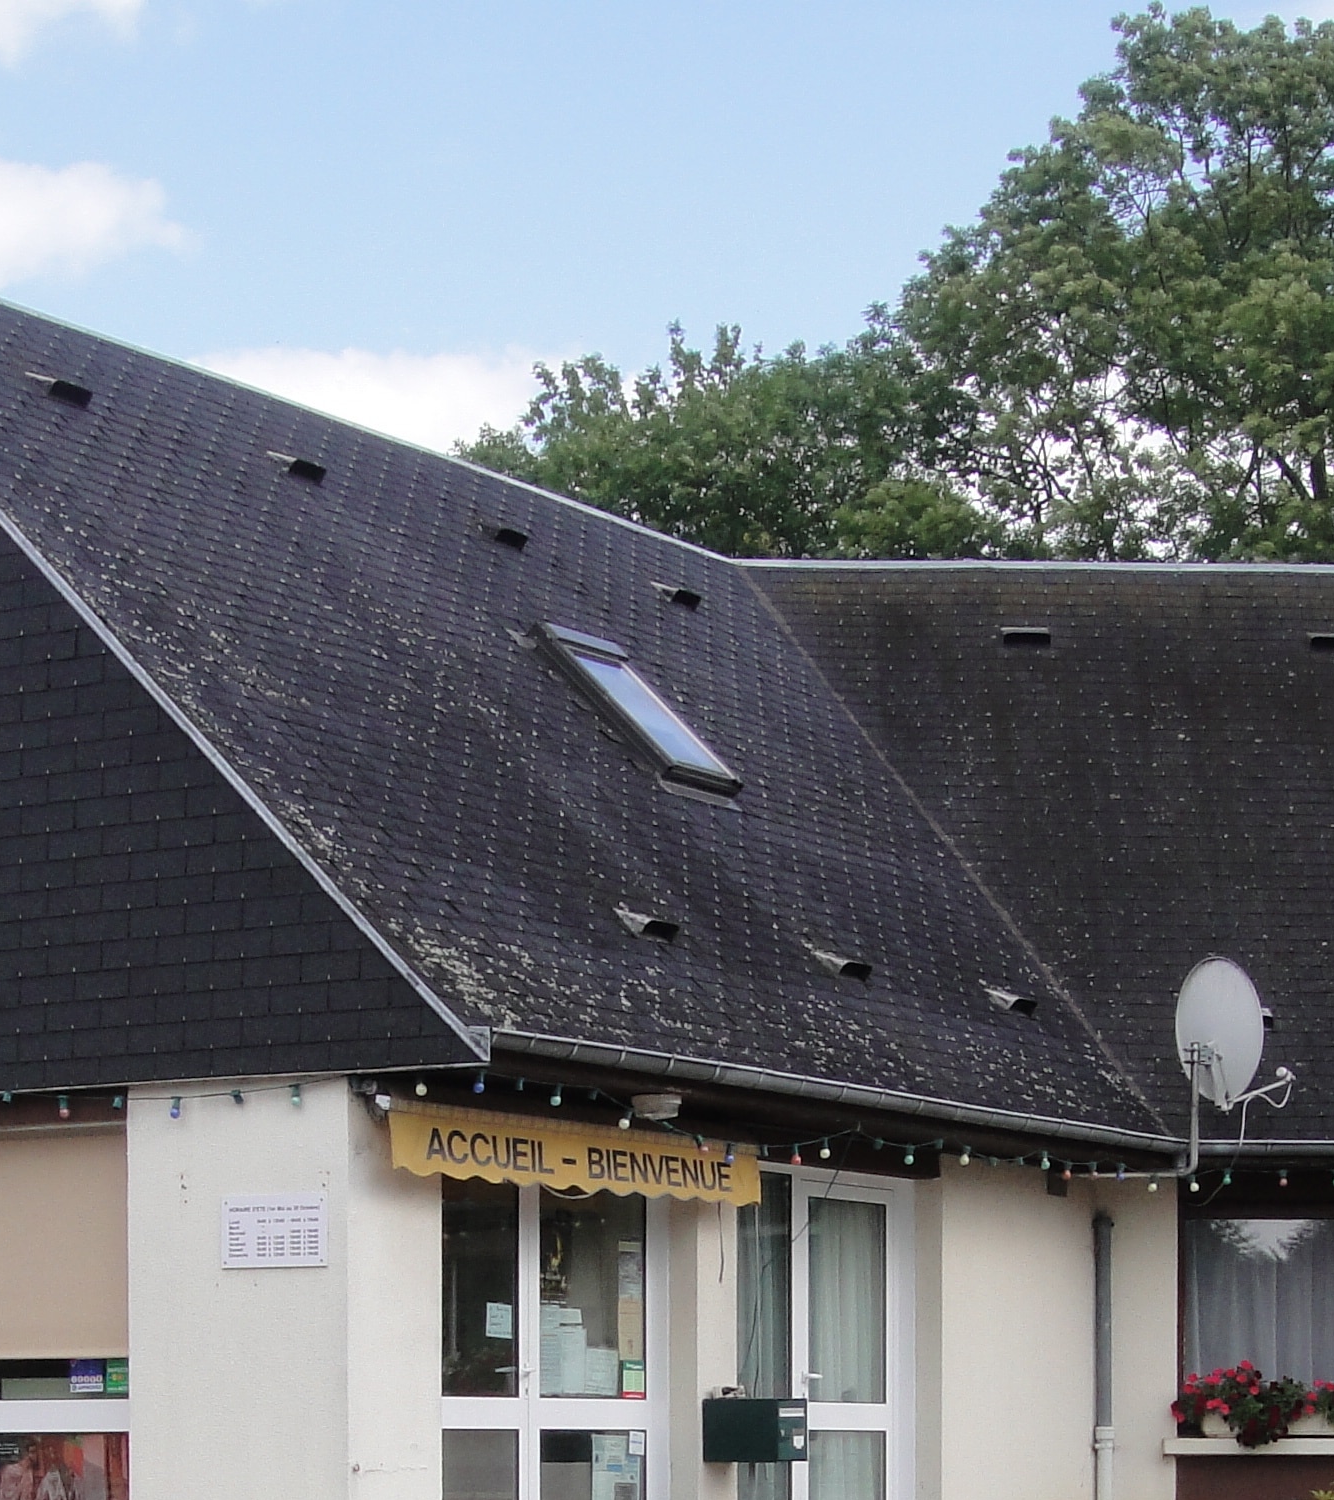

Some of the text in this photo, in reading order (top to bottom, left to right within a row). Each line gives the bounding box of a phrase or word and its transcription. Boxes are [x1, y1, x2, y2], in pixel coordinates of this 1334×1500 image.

[426, 1127, 733, 1192] ACCUEIL - BIENVENUE
